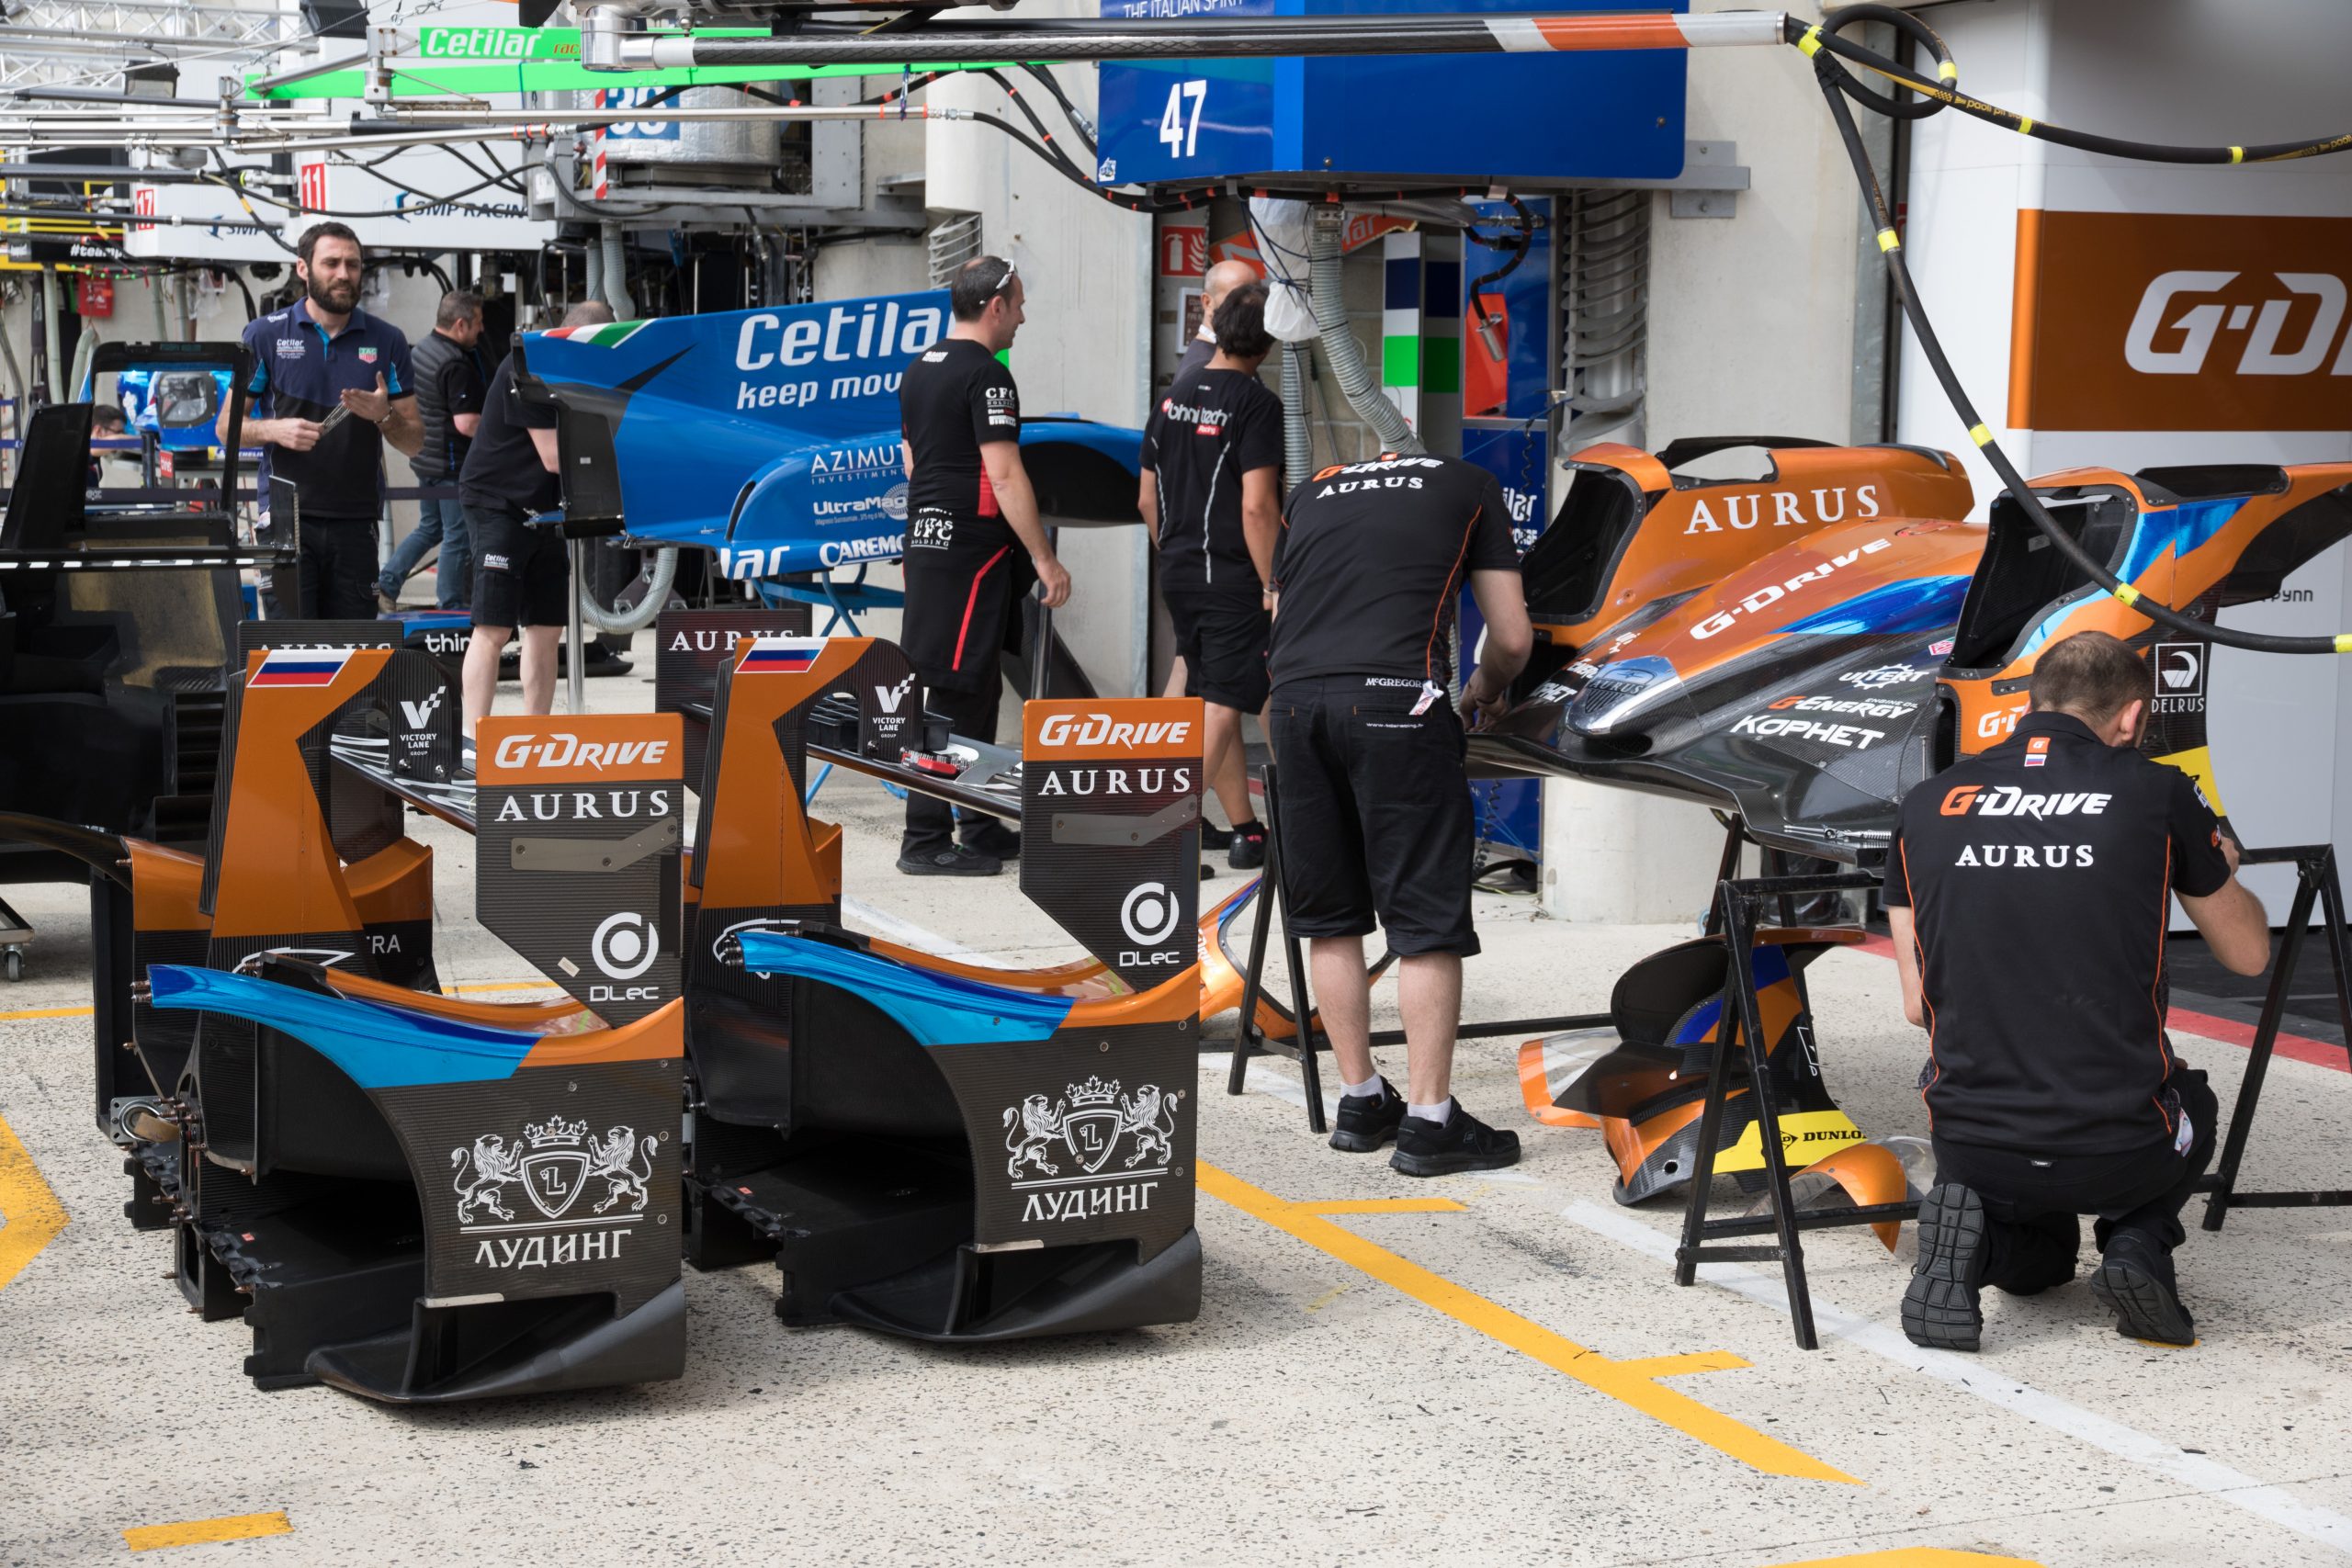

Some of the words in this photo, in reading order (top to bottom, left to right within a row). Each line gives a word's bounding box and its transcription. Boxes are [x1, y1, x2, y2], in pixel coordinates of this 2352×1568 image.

[1150, 0, 1200, 17] ITALIAN
[426, 28, 542, 57] Cetilar
[1159, 80, 1207, 158] 47
[303, 164, 323, 214] 11
[137, 191, 154, 230] 17
[464, 202, 528, 219] RACIN
[737, 381, 819, 410] keep
[1317, 476, 1423, 499] AURUS
[1683, 484, 1880, 536] AURUS
[1589, 680, 1644, 695] AURUS
[2151, 697, 2205, 714] DELRUS
[873, 716, 906, 725] VICTORY
[400, 733, 437, 741] VICTORY
[1038, 767, 1192, 796] AURUS
[494, 790, 670, 822] AURUS
[1955, 844, 2094, 868] AURUS
[366, 934, 401, 954] RA
[1803, 1130, 1867, 1142] DUNLO
